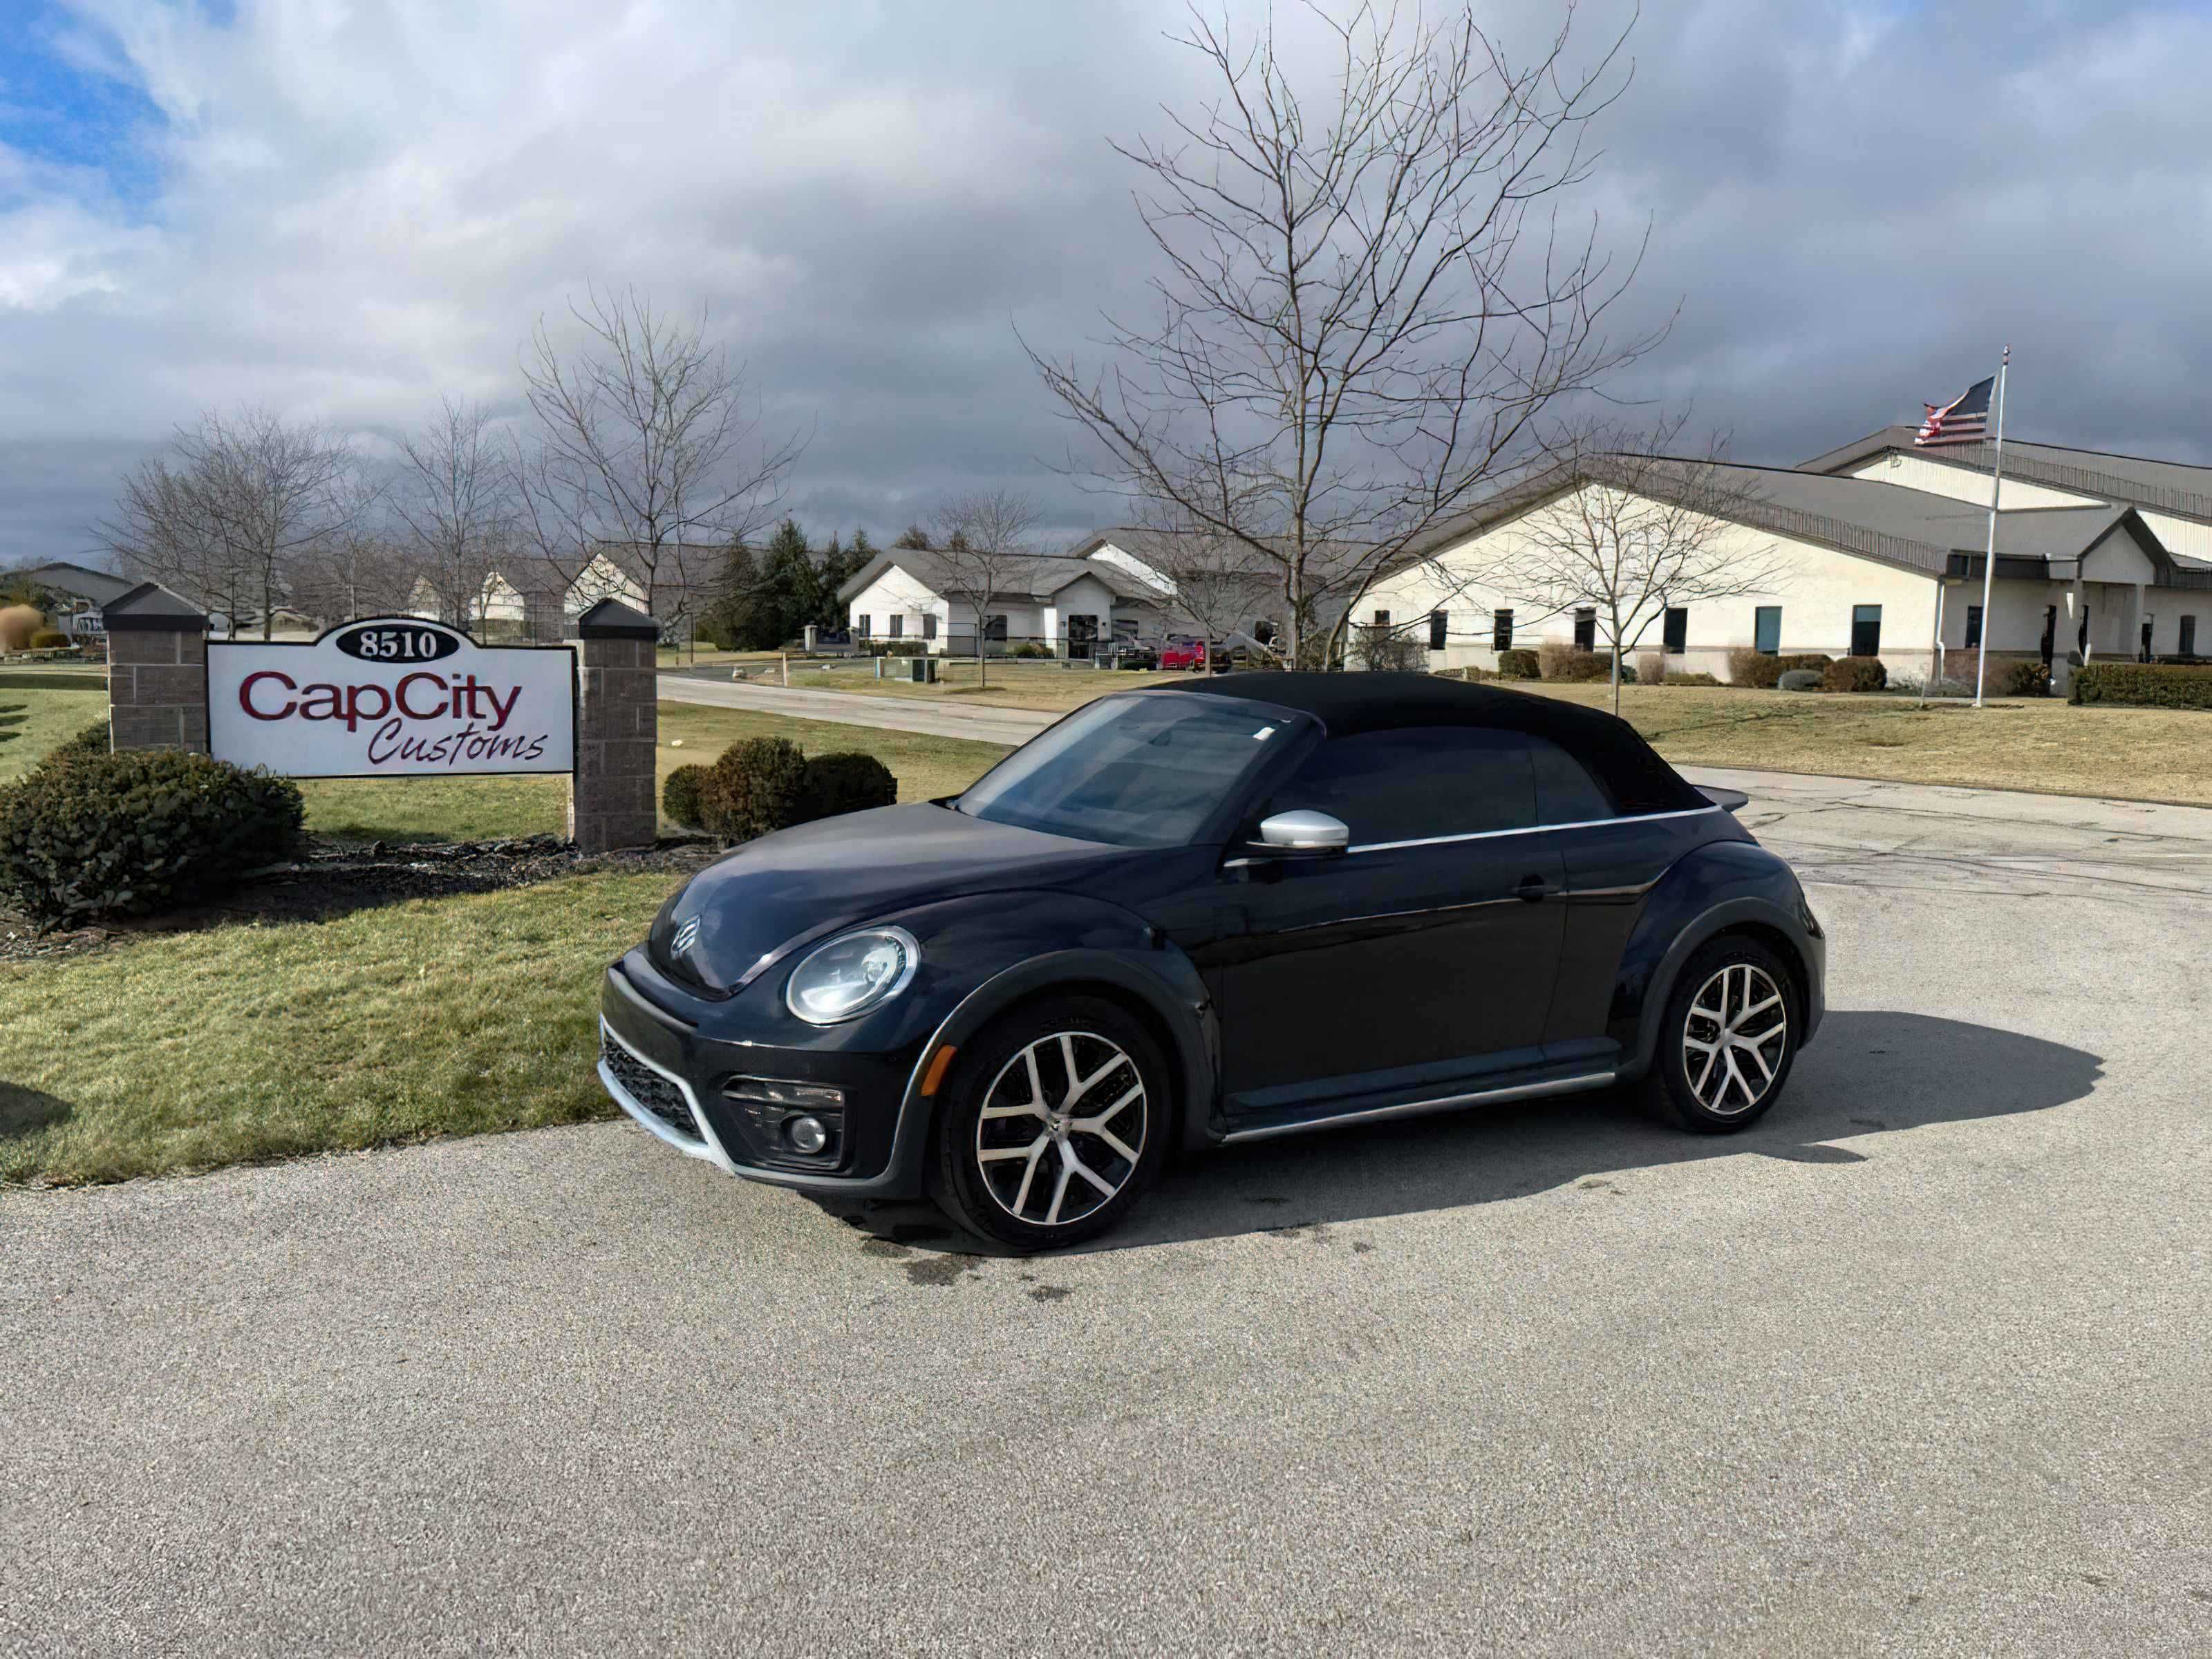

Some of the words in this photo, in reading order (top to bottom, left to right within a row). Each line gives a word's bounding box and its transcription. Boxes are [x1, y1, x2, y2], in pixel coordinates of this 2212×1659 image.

[359, 631, 438, 658] 8510
[239, 671, 523, 732] CapCity
[368, 718, 548, 765] Customs
